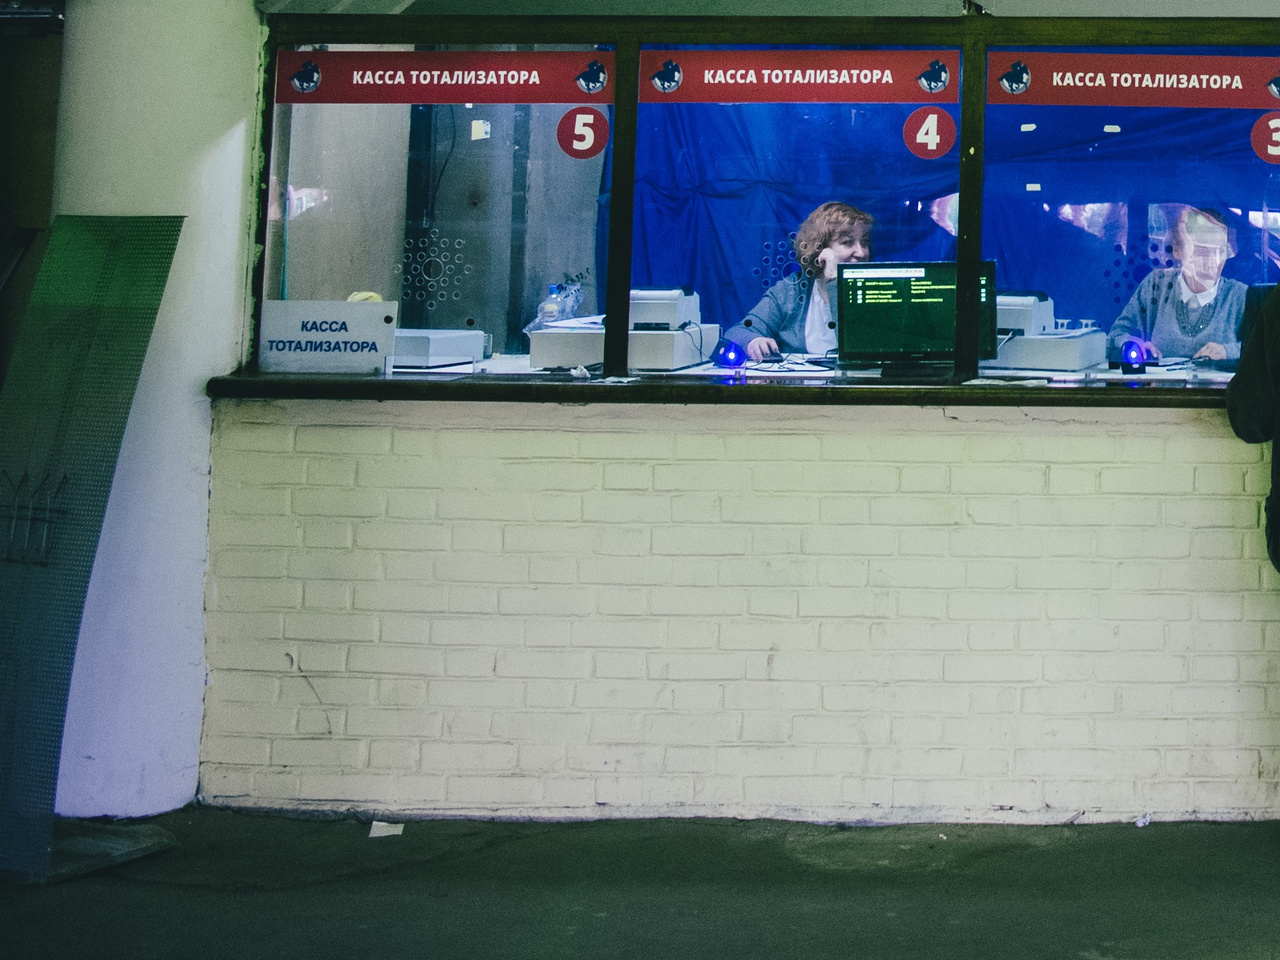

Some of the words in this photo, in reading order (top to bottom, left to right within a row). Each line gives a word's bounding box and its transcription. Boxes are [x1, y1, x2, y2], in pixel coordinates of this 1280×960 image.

[352, 70, 406, 85] КАССА
[409, 70, 541, 86] ТОТАЛИЗАТОРА
[703, 69, 758, 84] КАССА
[761, 69, 894, 85] ТОТАЛИЗАТОРА
[1052, 71, 1106, 88] КАССА
[1110, 72, 1243, 90] ТОТАЛИЗАТОРА
[573, 113, 596, 151] 5
[915, 113, 941, 150] 4
[300, 320, 349, 333] КАССА
[267, 339, 379, 353] ТОТАЛИЗАТОРА
